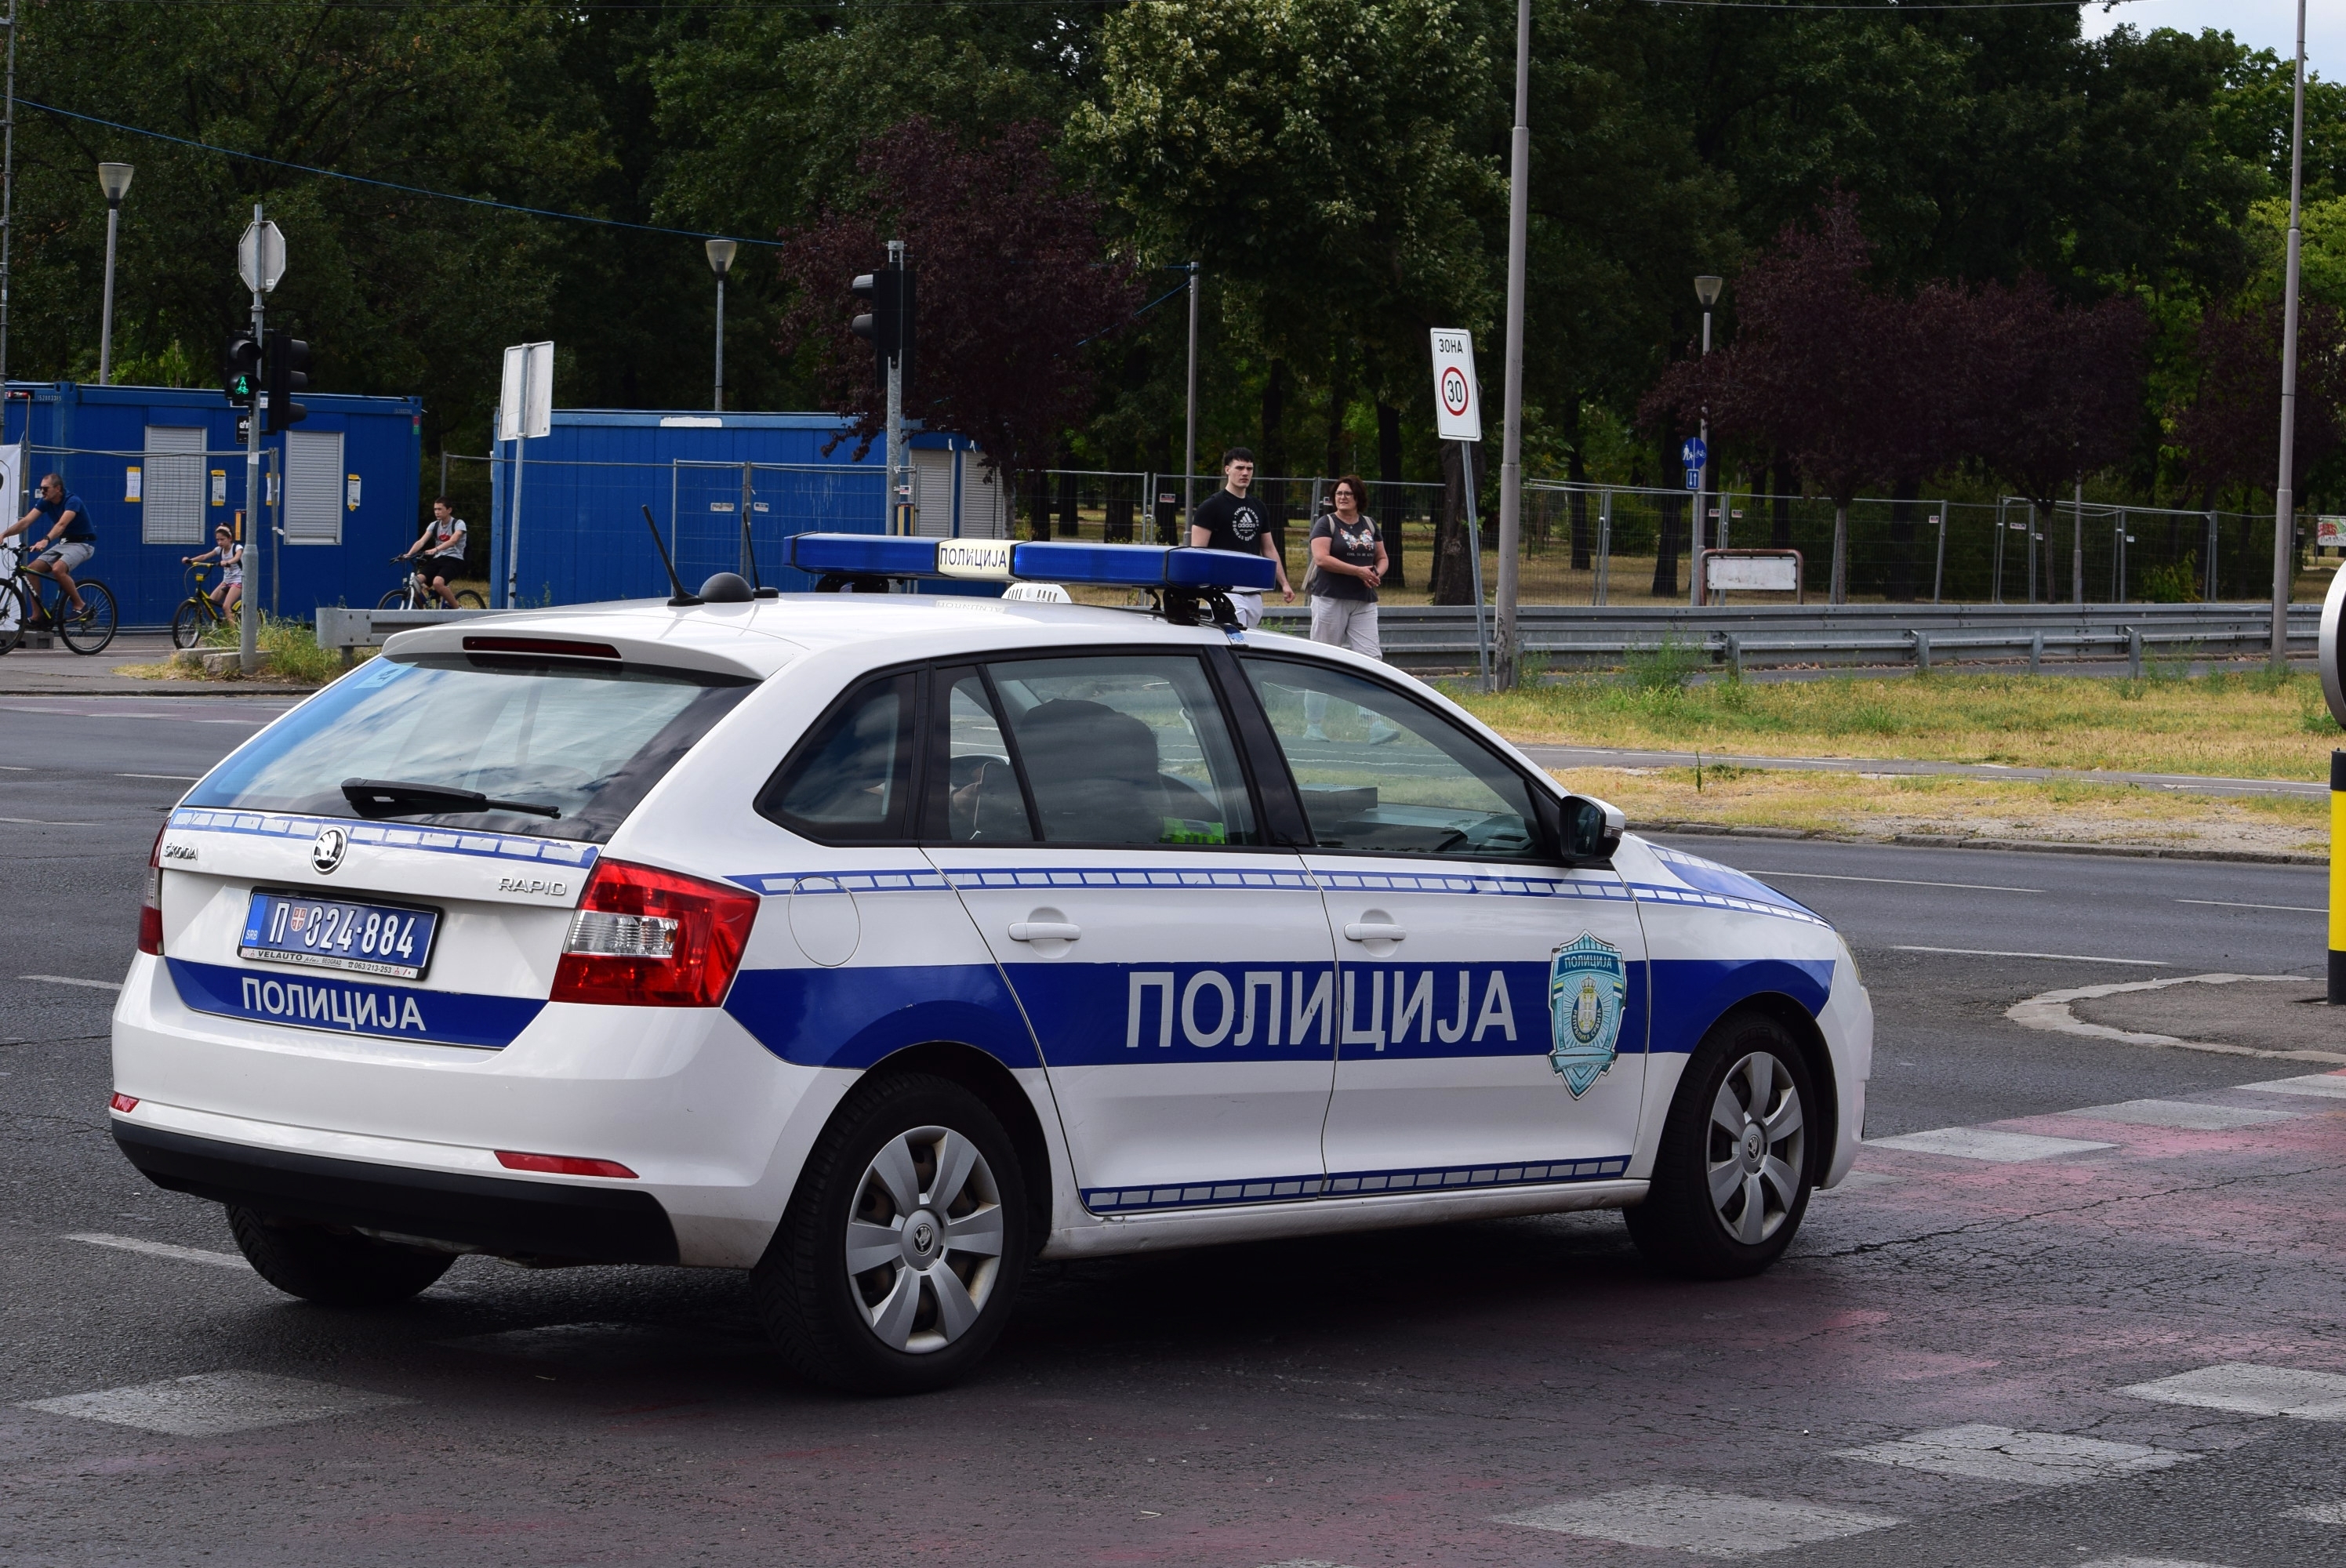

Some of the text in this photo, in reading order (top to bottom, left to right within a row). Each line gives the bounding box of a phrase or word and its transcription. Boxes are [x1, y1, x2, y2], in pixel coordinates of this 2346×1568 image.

[1439, 339, 1463, 354] ЗОНА
[1447, 379, 1462, 403] 30
[939, 547, 1007, 570] ПОЛИЦИЈА
[498, 877, 567, 896] RAPID
[245, 929, 259, 941] SRB
[258, 950, 303, 961] VELAUTO
[321, 957, 343, 966] BEOGRAD
[1564, 954, 1612, 969] ПОЛИЦИЈА
[242, 977, 427, 1032] ПОЛИЦИЈА
[1126, 970, 1518, 1051] ПОЛИЦИЈА
